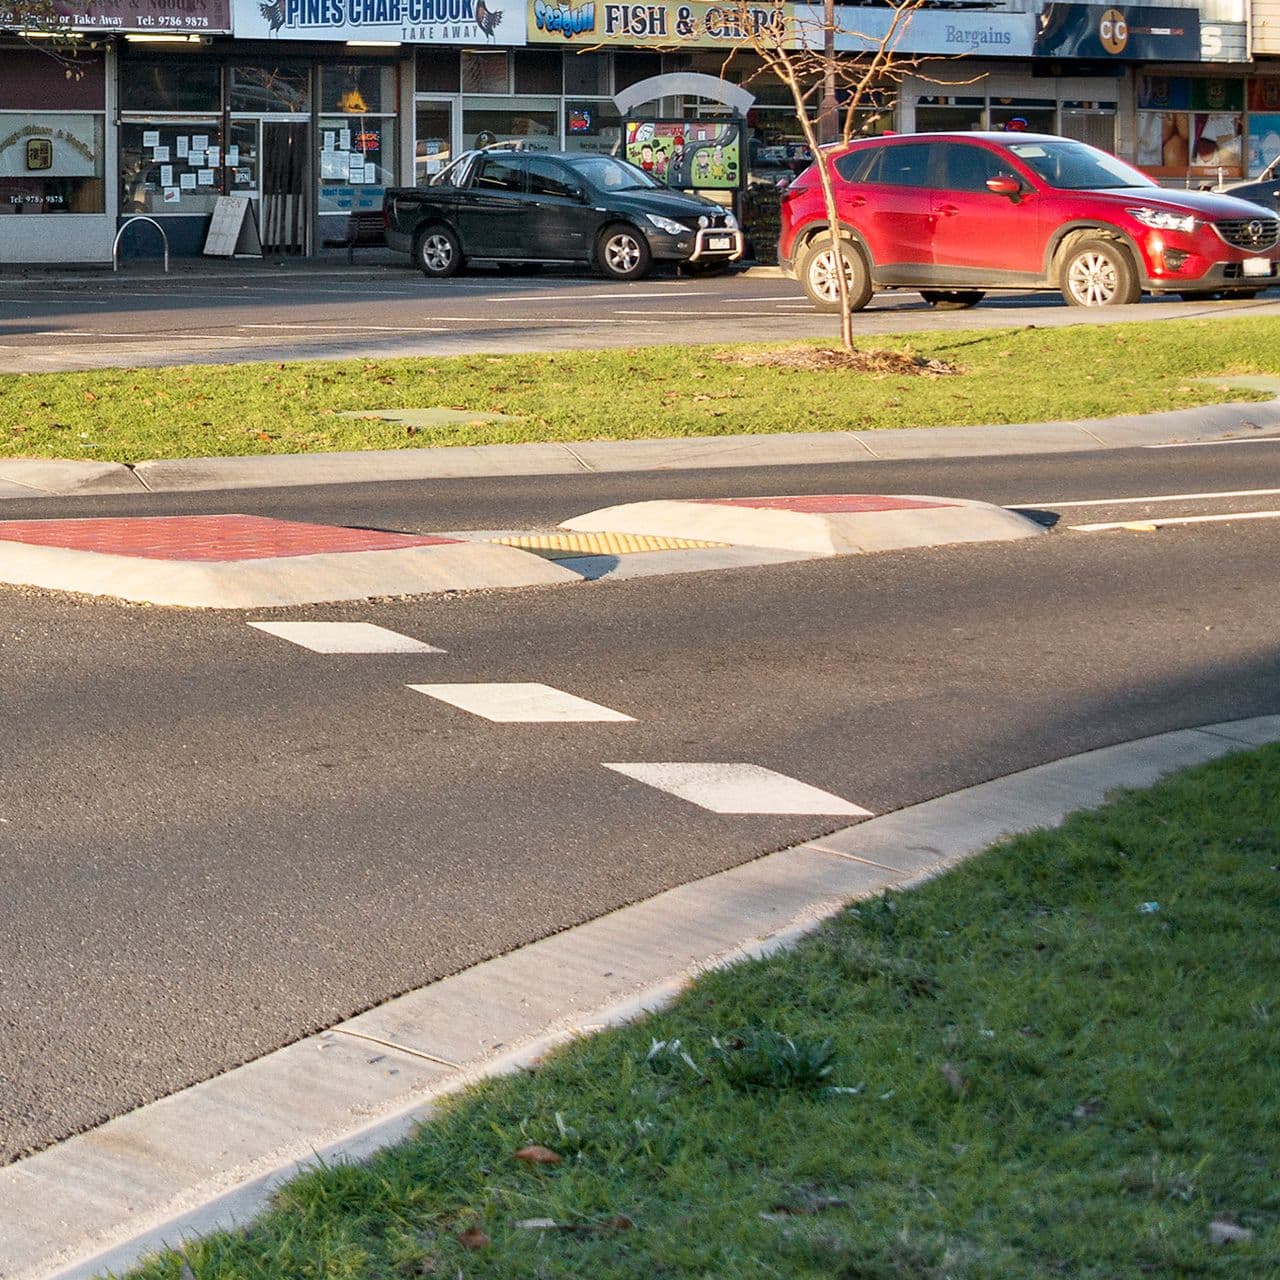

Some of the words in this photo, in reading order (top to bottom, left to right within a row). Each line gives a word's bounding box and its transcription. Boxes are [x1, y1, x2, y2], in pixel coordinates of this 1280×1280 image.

[59, 15, 70, 24] or
[73, 14, 97, 24] Take
[99, 15, 124, 27] Away
[137, 16, 155, 26] Tel:
[158, 16, 182, 26] 9786
[185, 17, 208, 27] 9878
[605, 4, 666, 36] FISH
[676, 5, 695, 36] &
[402, 27, 434, 40] TAKE
[443, 26, 478, 39] AWAY
[945, 25, 1011, 48] Bargains
